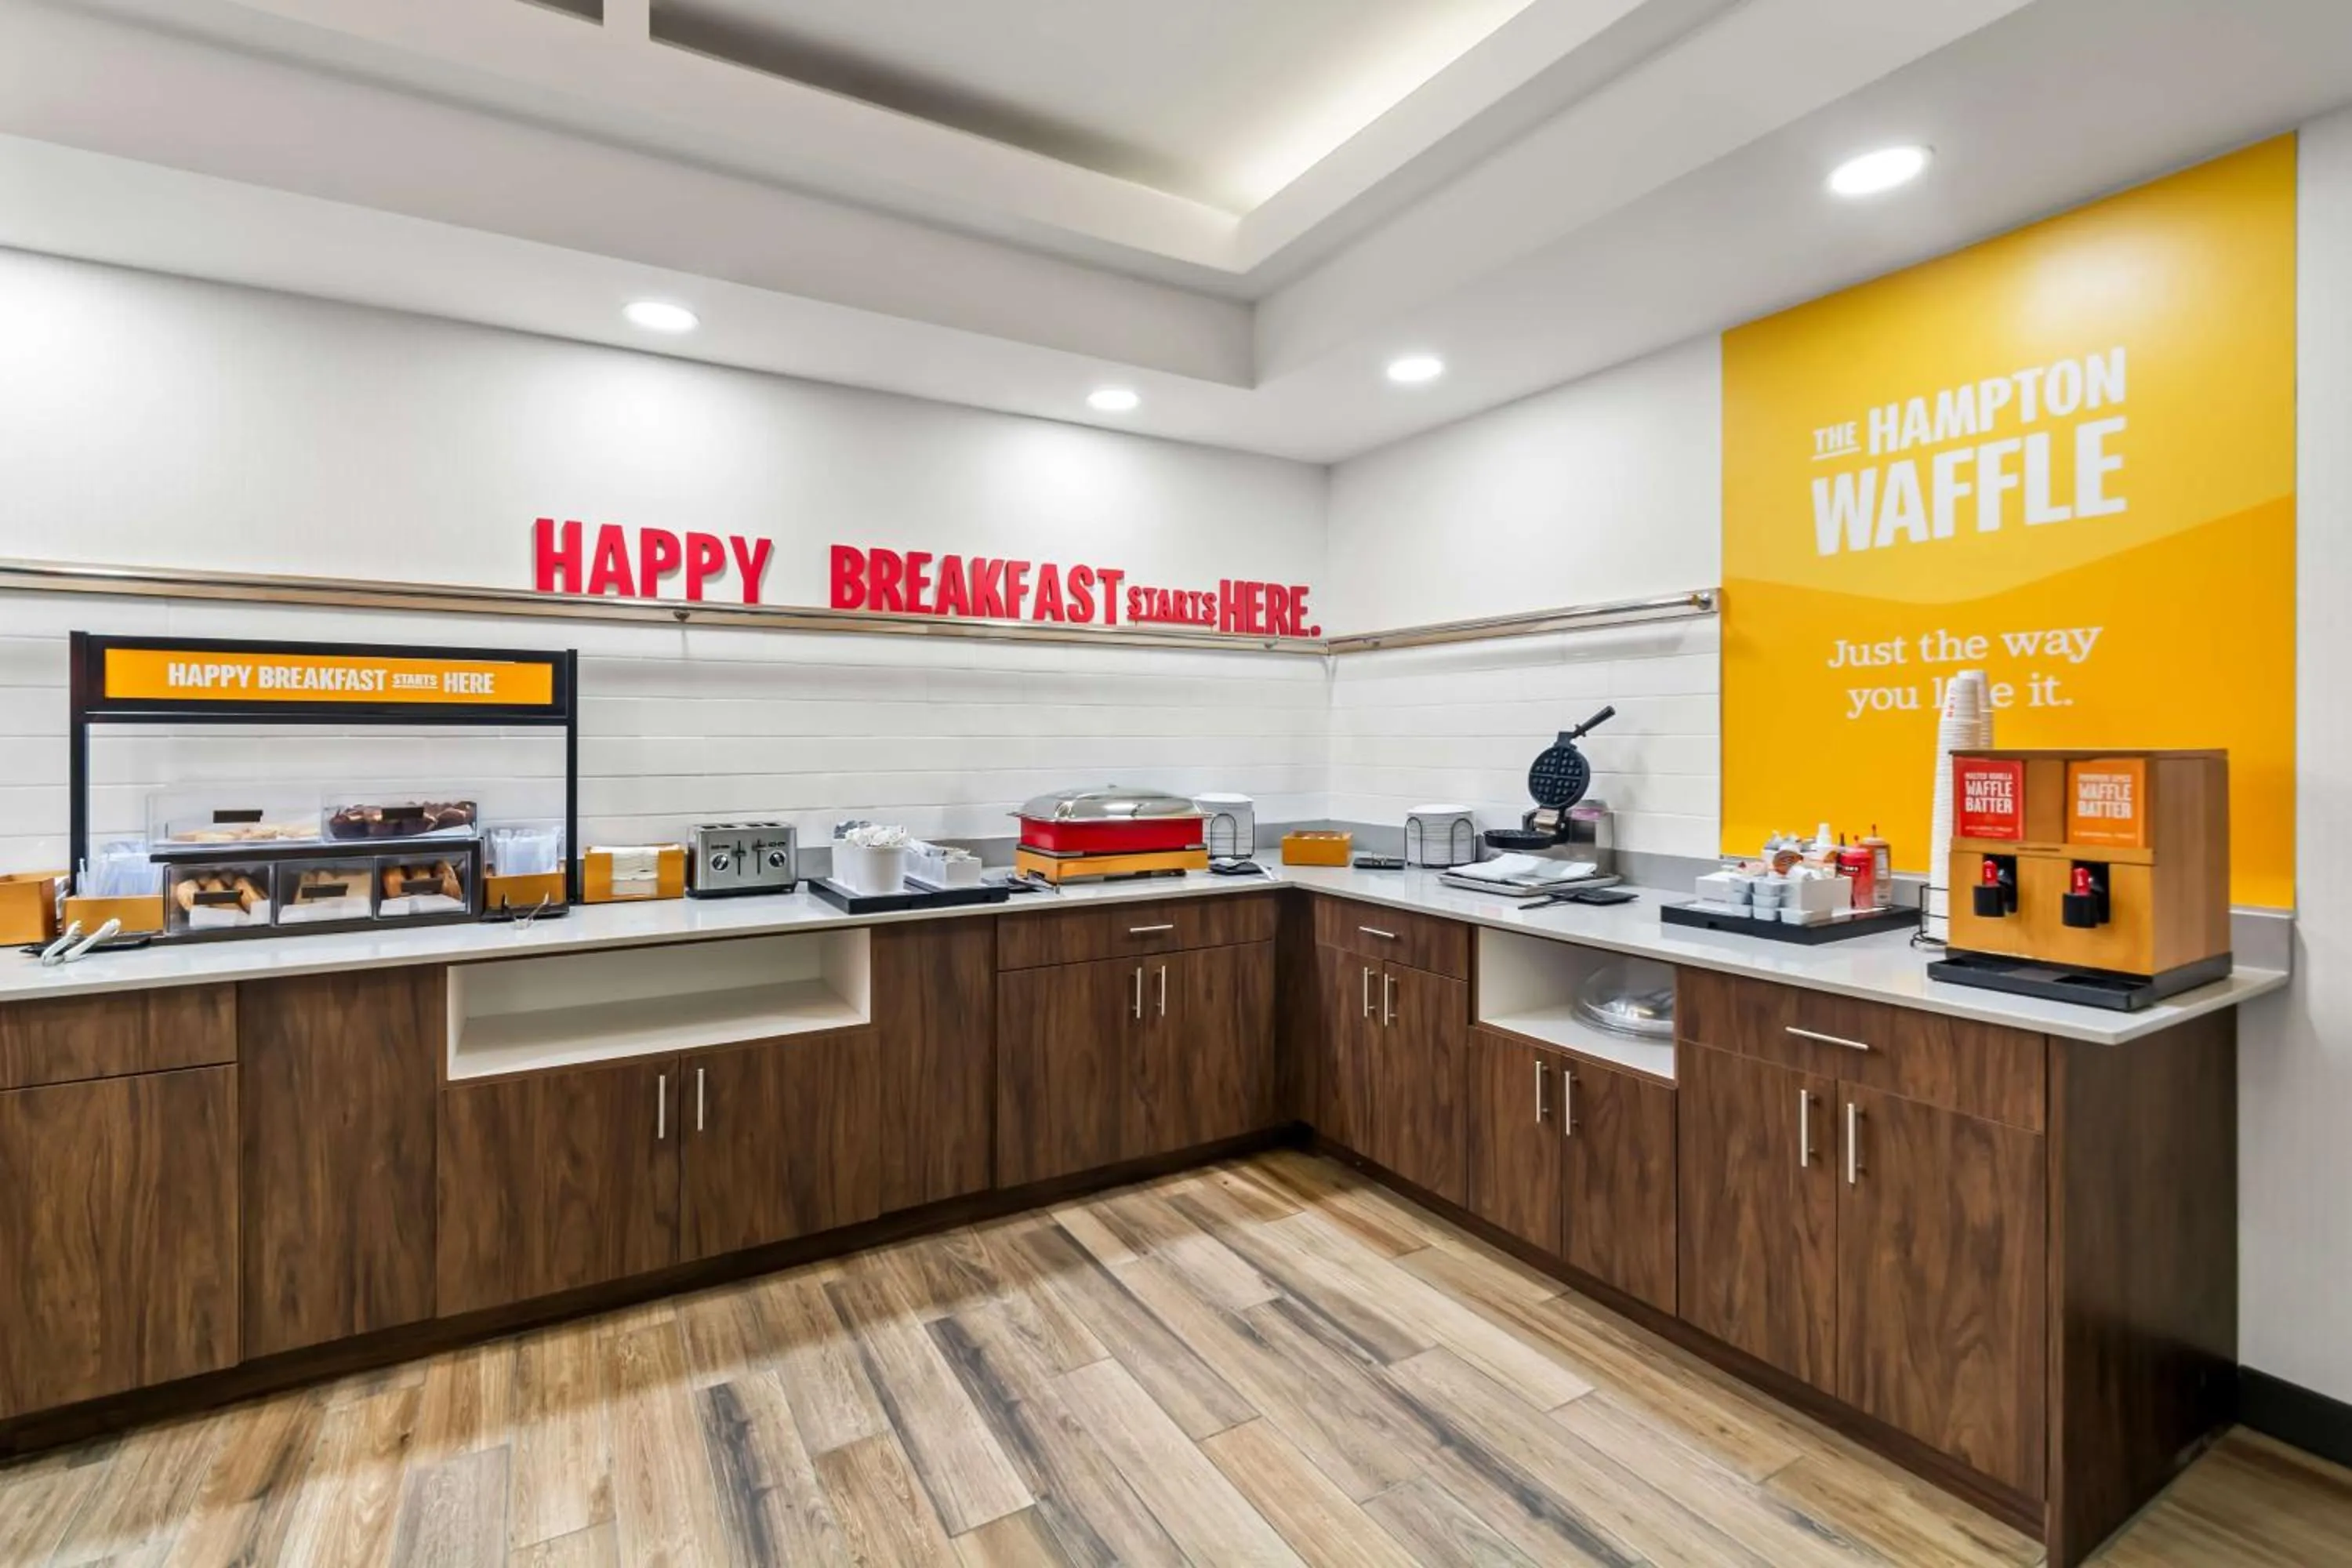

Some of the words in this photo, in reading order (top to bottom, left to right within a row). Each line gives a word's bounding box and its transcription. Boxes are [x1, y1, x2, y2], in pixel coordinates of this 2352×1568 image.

[1812, 421, 1857, 452] THE
[1868, 346, 2125, 456] HAMPTON
[1812, 415, 2127, 557] WAFFLE
[533, 517, 772, 605] HAPPY
[829, 544, 1124, 625] BREAKFAST
[1127, 586, 1217, 626] STARTS
[1219, 579, 1322, 637] HERE.
[1828, 636, 1907, 668] Just
[1918, 629, 1989, 662] the
[2000, 626, 2103, 663] way
[168, 662, 252, 688] HAPPY
[258, 666, 387, 691] BREAKFAST
[392, 673, 438, 689] STARTS
[443, 672, 495, 694] HERE
[1846, 685, 1921, 720] you
[1931, 677, 2015, 709] le
[2027, 672, 2074, 707] it.
[1965, 780, 2013, 797] WAFFLE
[1965, 797, 2013, 814] BATTER
[2078, 782, 2132, 800] WAFFLE
